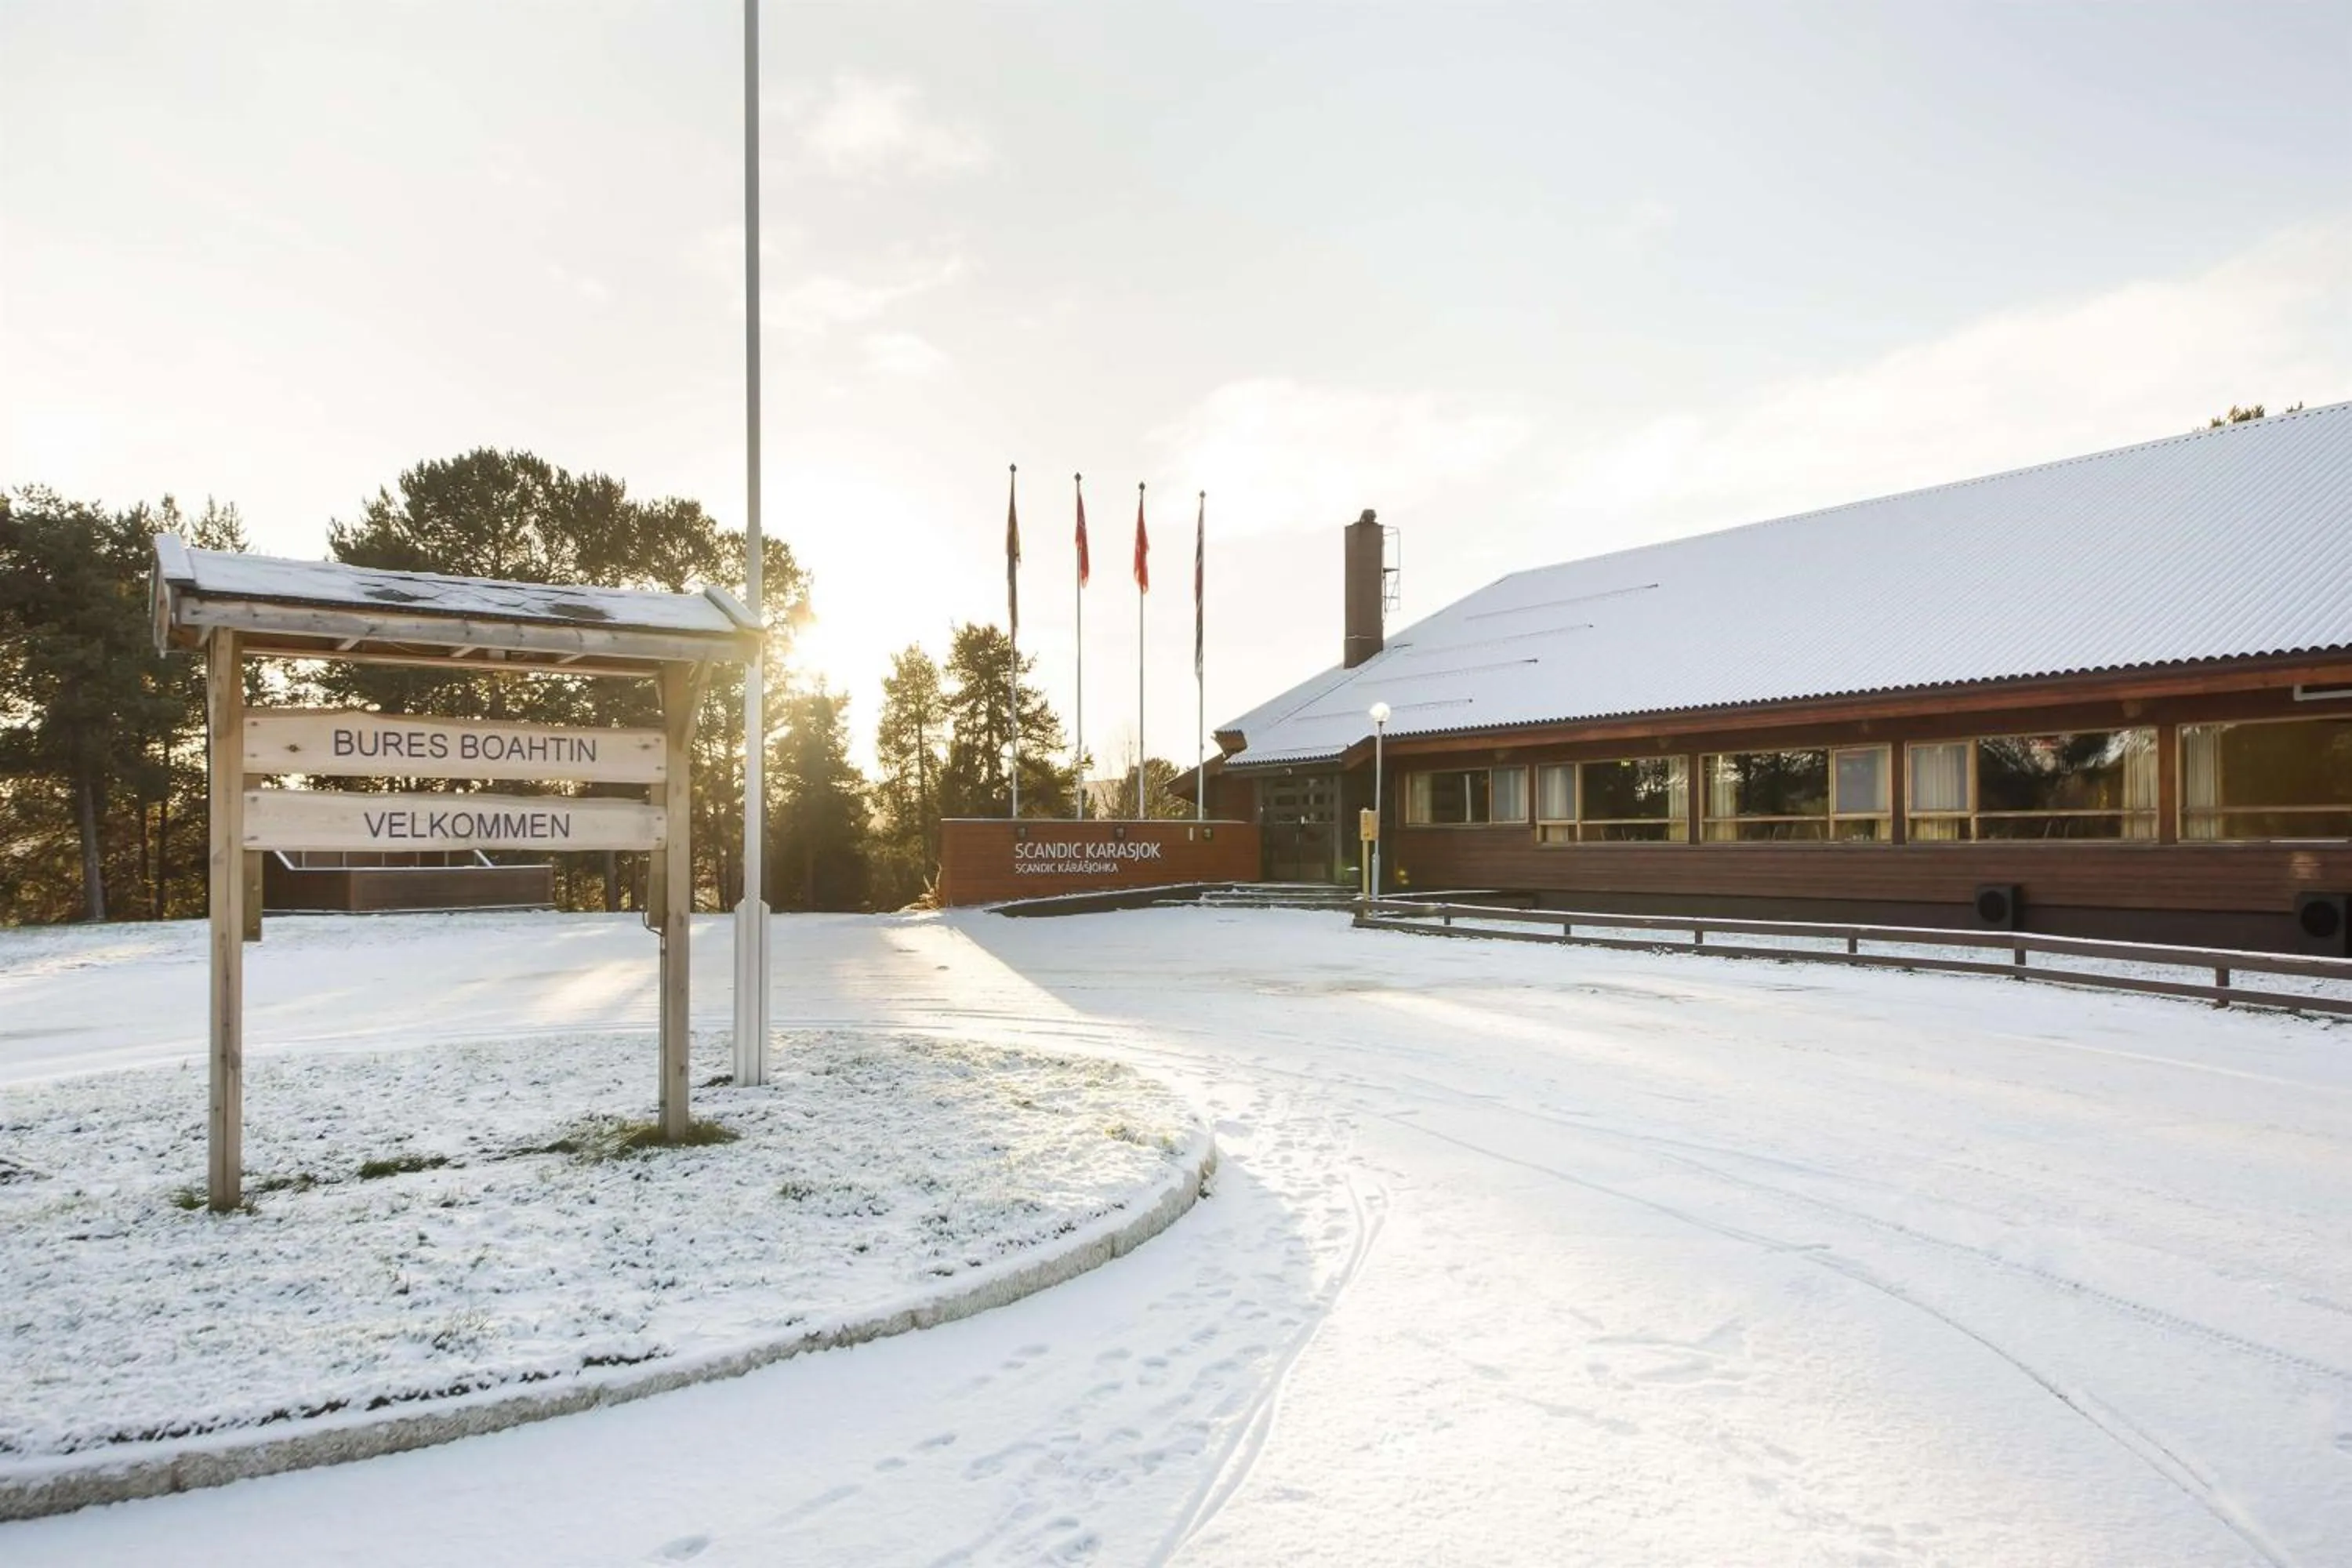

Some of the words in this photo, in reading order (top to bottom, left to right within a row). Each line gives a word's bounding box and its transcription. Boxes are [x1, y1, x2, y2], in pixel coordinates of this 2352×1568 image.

[334, 729, 448, 758] BURES
[459, 735, 597, 762] BOAHTIN
[363, 811, 571, 839] VELKOMMEN
[1015, 843, 1081, 858] SCANDIC
[1085, 842, 1161, 862] KARASJOK
[1015, 863, 1055, 873] SCANDIC
